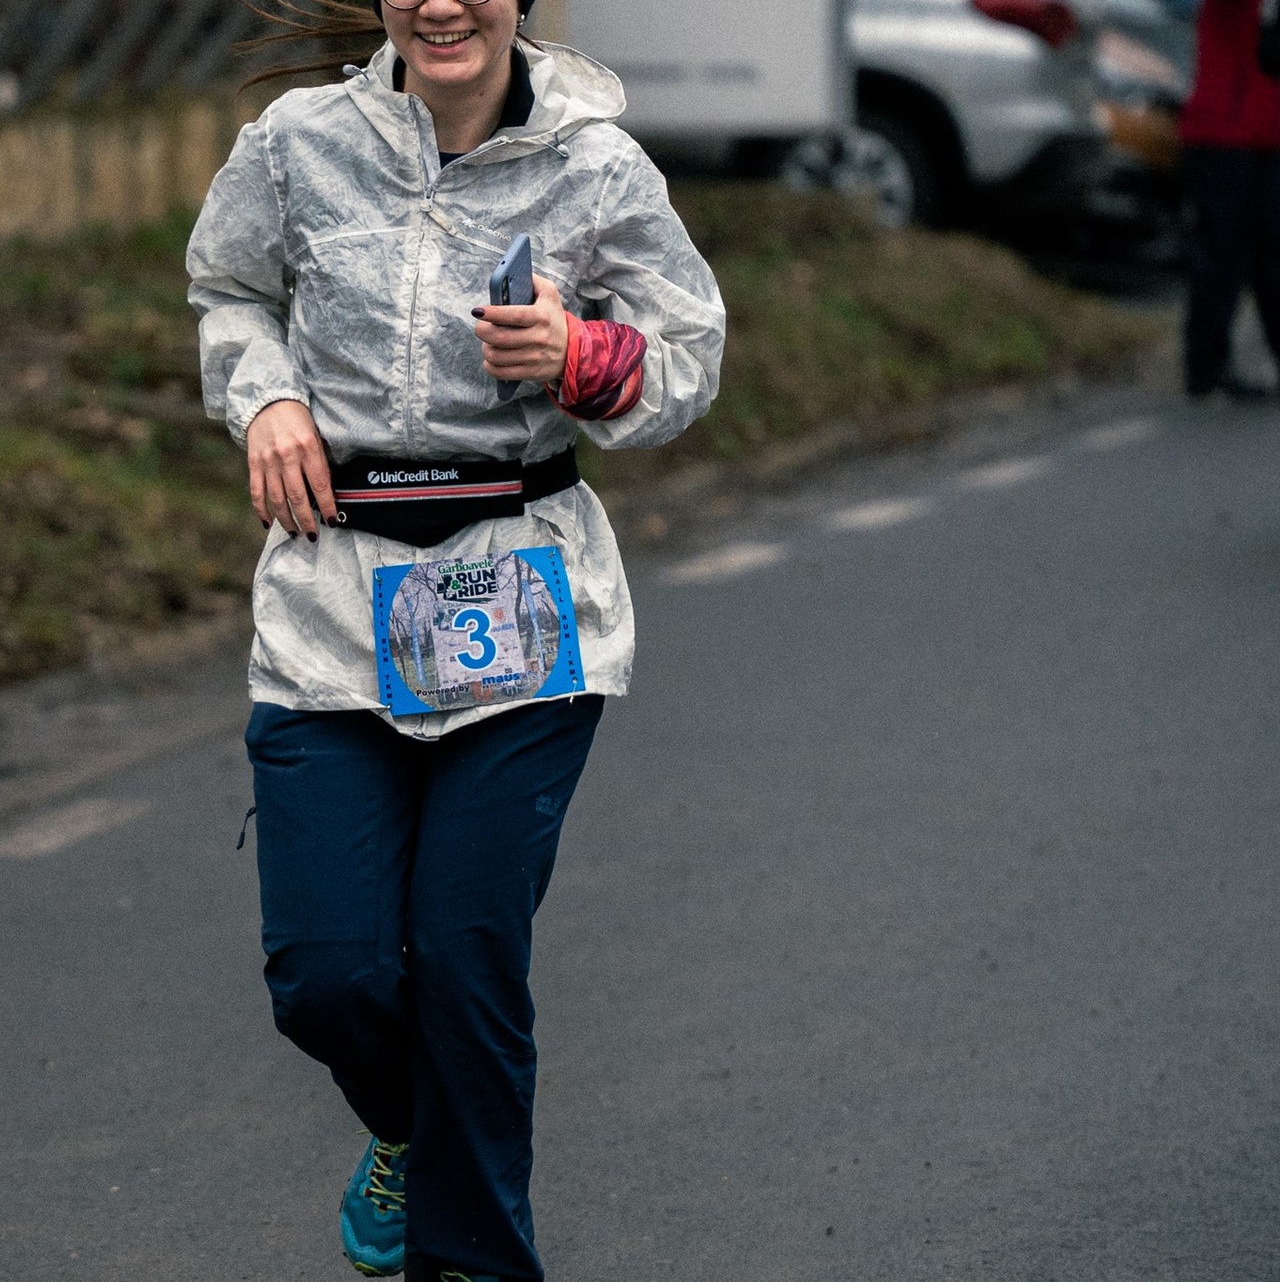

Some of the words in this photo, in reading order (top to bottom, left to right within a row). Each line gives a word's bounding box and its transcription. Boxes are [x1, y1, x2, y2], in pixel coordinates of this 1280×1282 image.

[380, 470, 429, 484] UniCredit
[431, 468, 459, 481] Bank
[455, 569, 497, 585] RUN
[458, 582, 499, 597] RIDE
[551, 561, 564, 602] TRAIL
[562, 615, 570, 639] RUN
[453, 608, 497, 670] 3
[381, 638, 389, 662] RUN
[482, 673, 520, 685] maus
[416, 686, 456, 696] Powered
[458, 685, 470, 693] by
